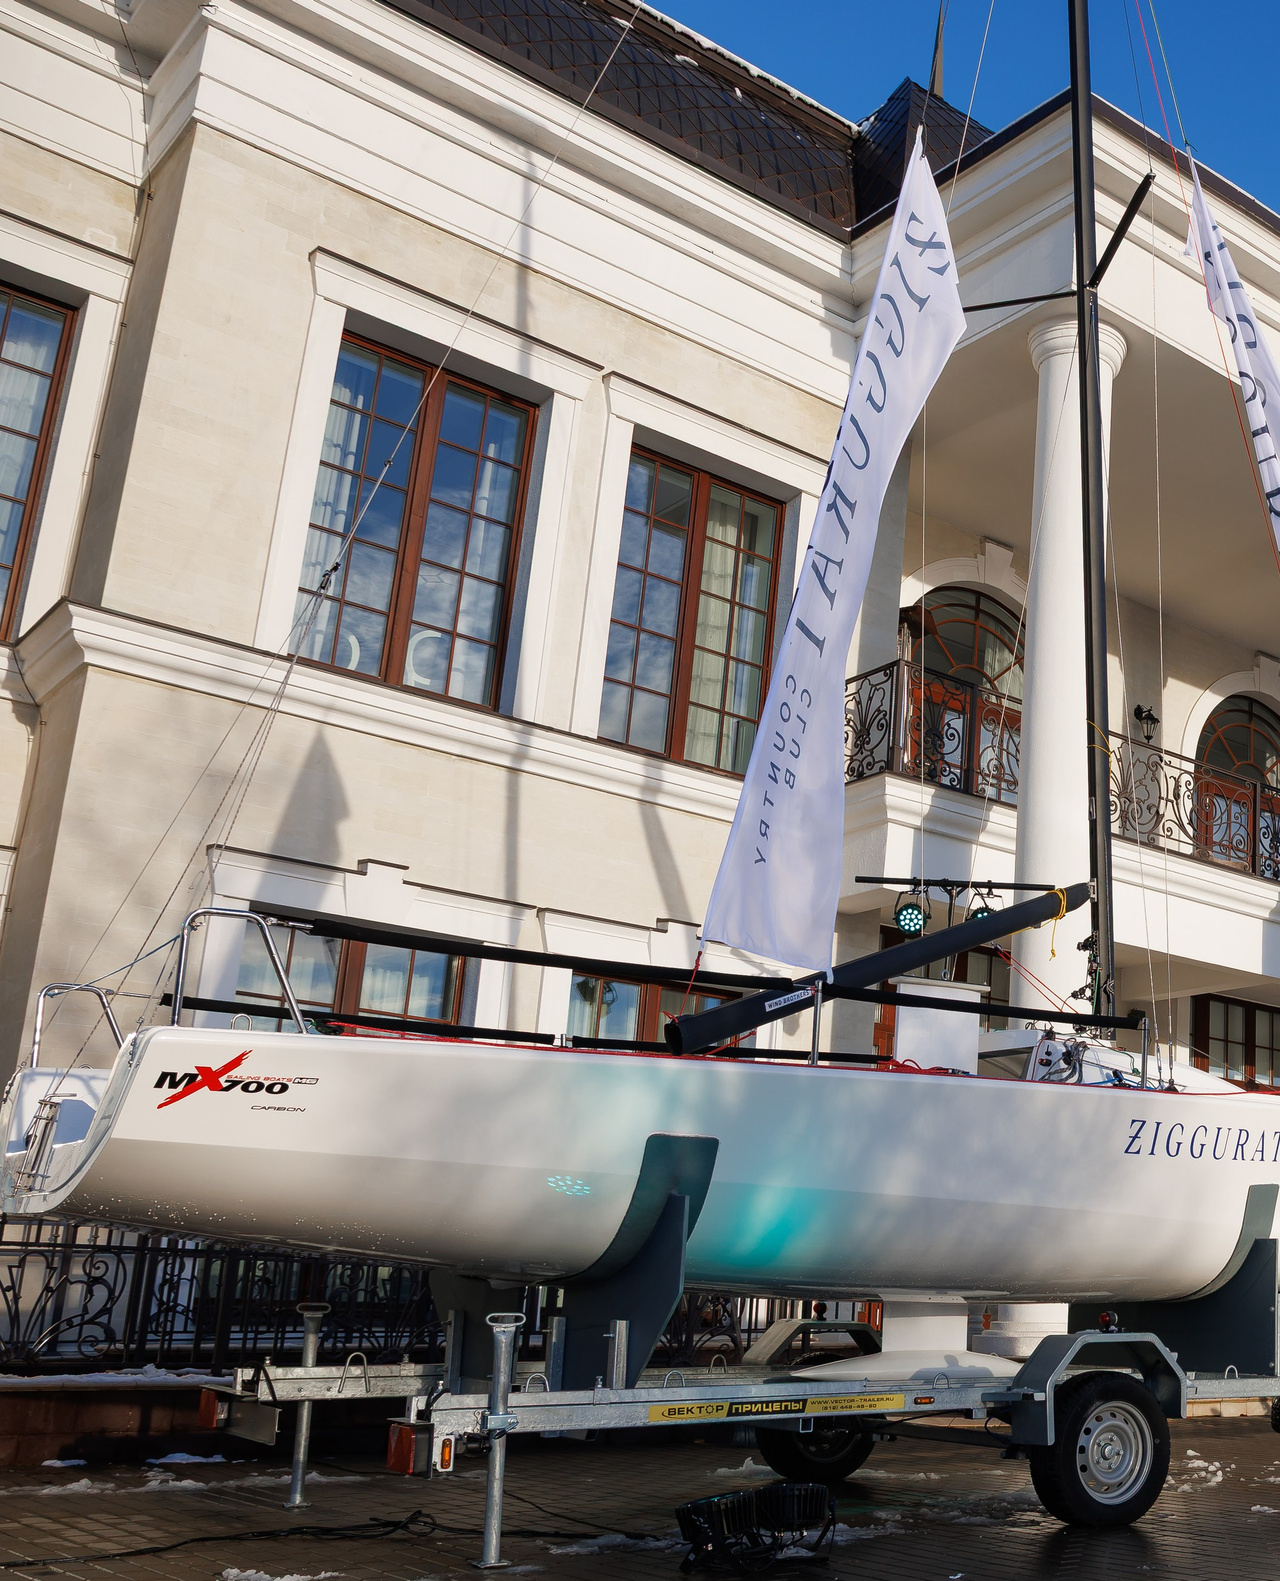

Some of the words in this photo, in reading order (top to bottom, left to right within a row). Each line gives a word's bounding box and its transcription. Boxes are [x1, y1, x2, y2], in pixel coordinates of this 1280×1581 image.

[767, 1001, 783, 1009] WIND
[783, 990, 809, 1003] BROTHERS
[250, 1105, 307, 1113] CARBON
[667, 1404, 725, 1416] ВЕКТОР
[732, 1401, 803, 1414] ПРИЦЕПЫ
